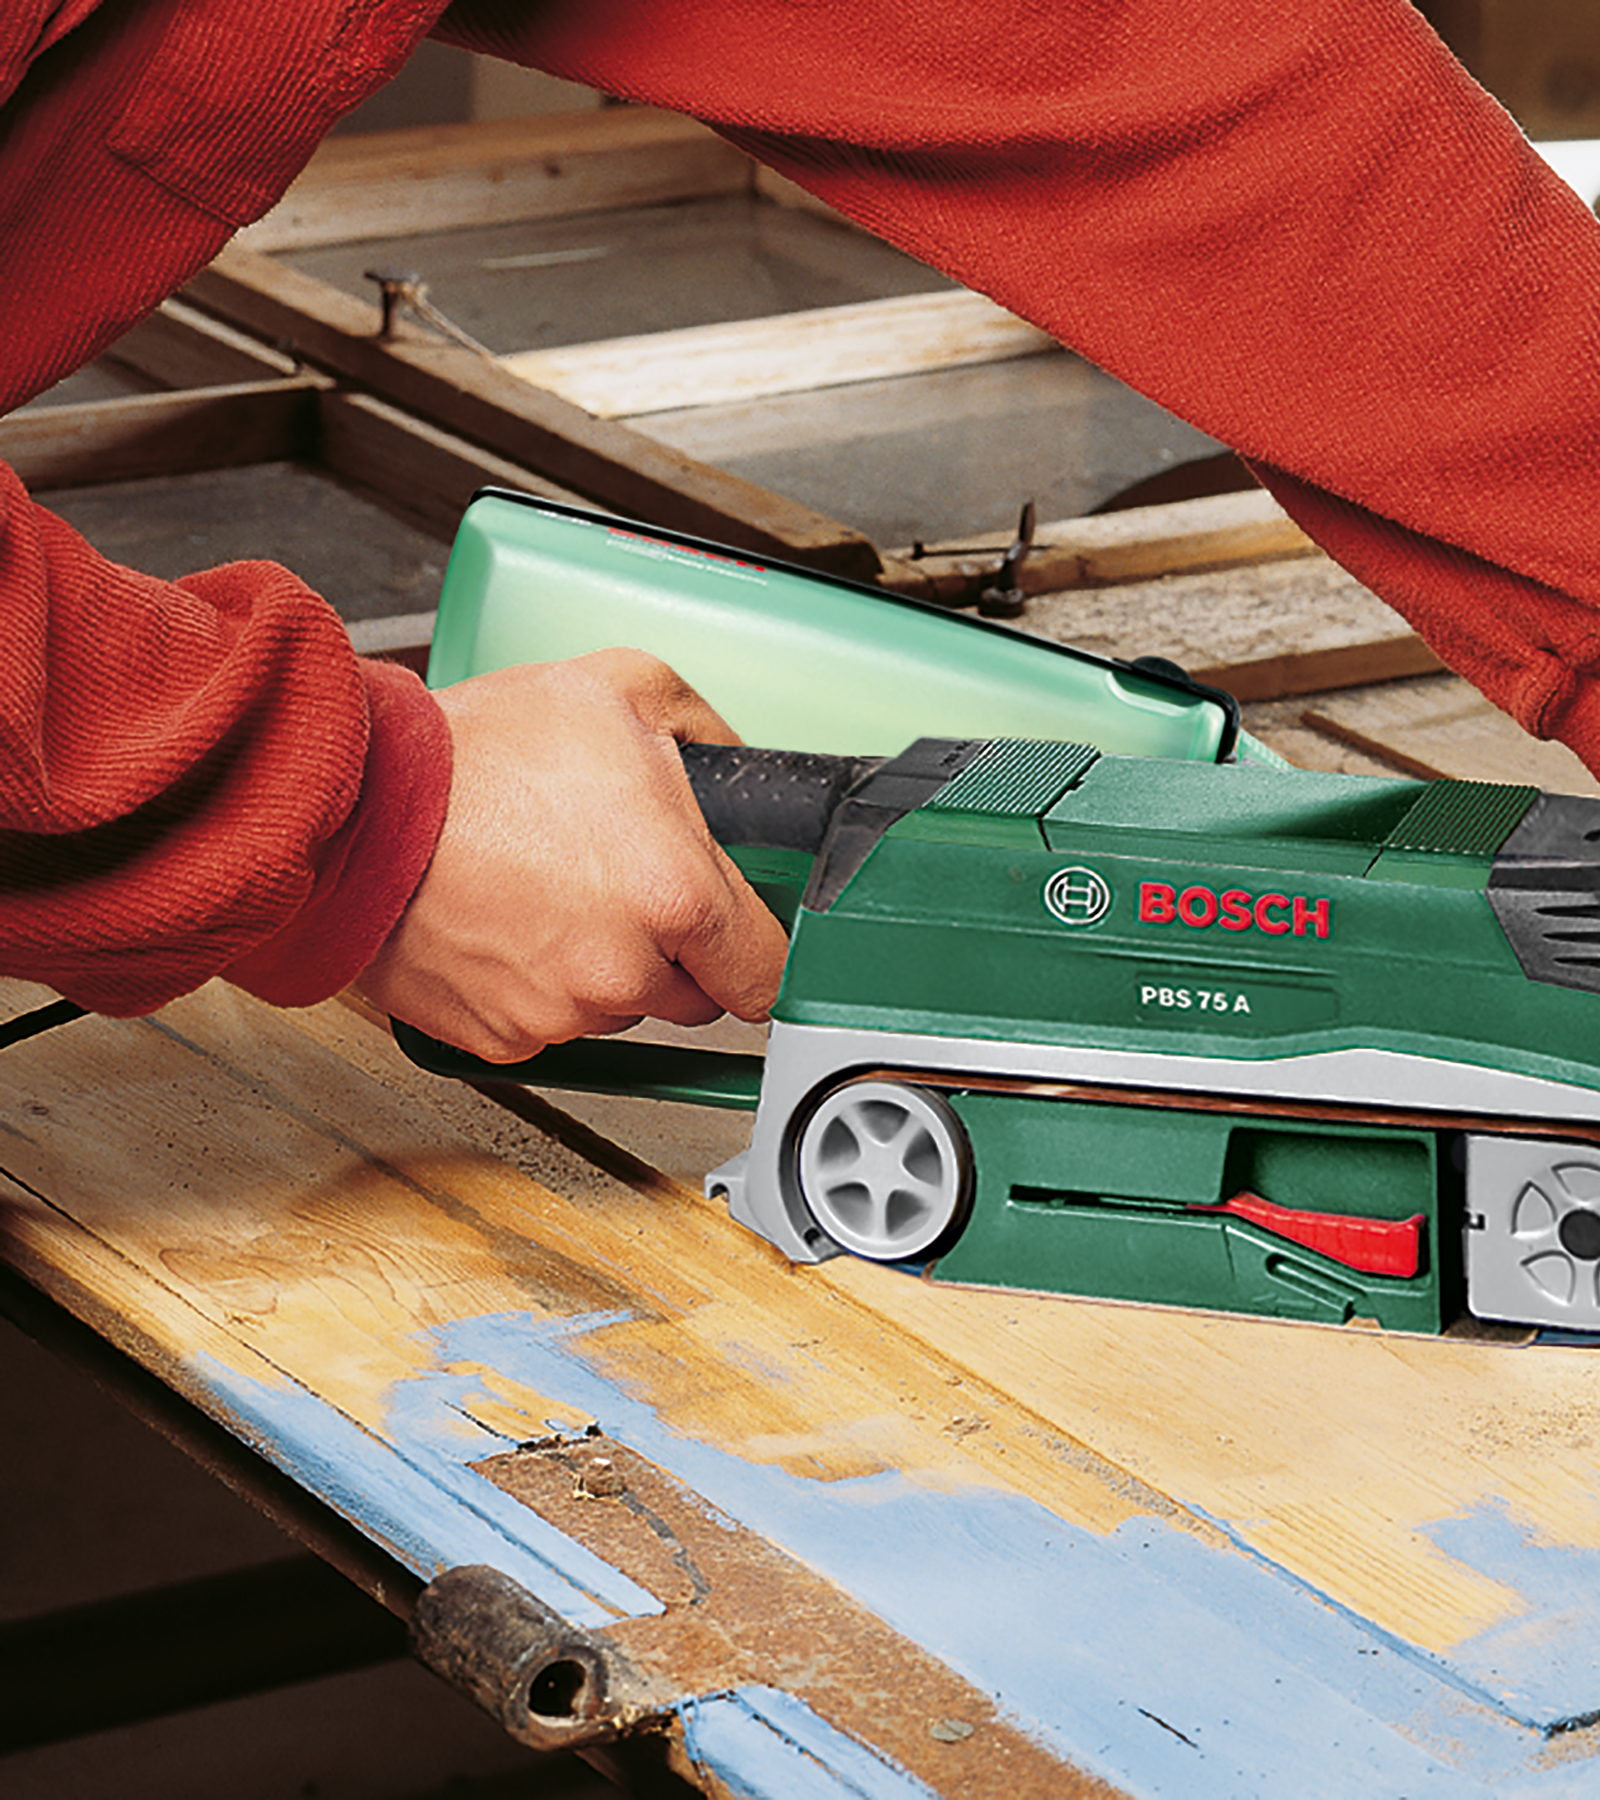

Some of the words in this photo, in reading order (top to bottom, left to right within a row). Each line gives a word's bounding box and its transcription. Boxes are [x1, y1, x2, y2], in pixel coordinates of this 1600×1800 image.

[1139, 882, 1330, 938] BOSCH
[1141, 986, 1191, 1009] PBS
[1197, 991, 1228, 1012] 75
[1233, 994, 1251, 1014] A
